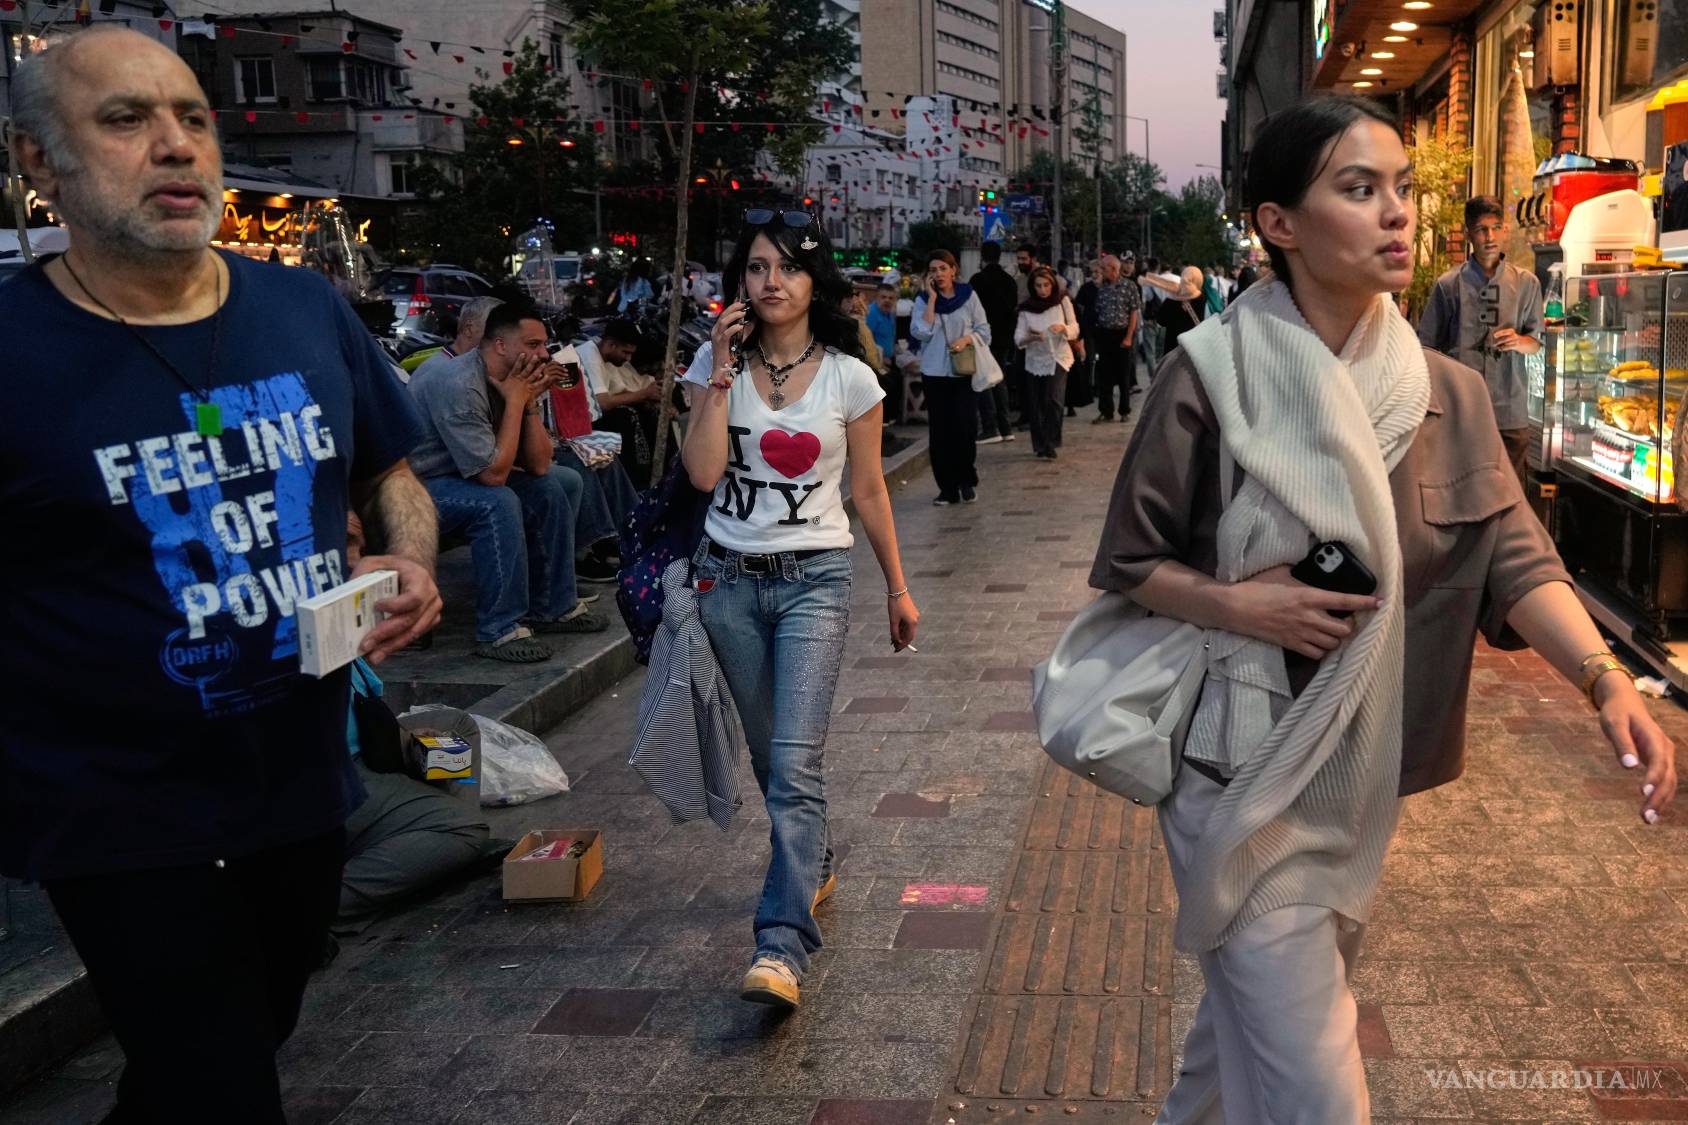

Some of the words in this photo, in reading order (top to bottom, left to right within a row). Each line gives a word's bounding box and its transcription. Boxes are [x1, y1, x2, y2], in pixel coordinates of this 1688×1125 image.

[94, 404, 337, 505] FEELING
[727, 425, 751, 471] I
[210, 491, 279, 554] OF
